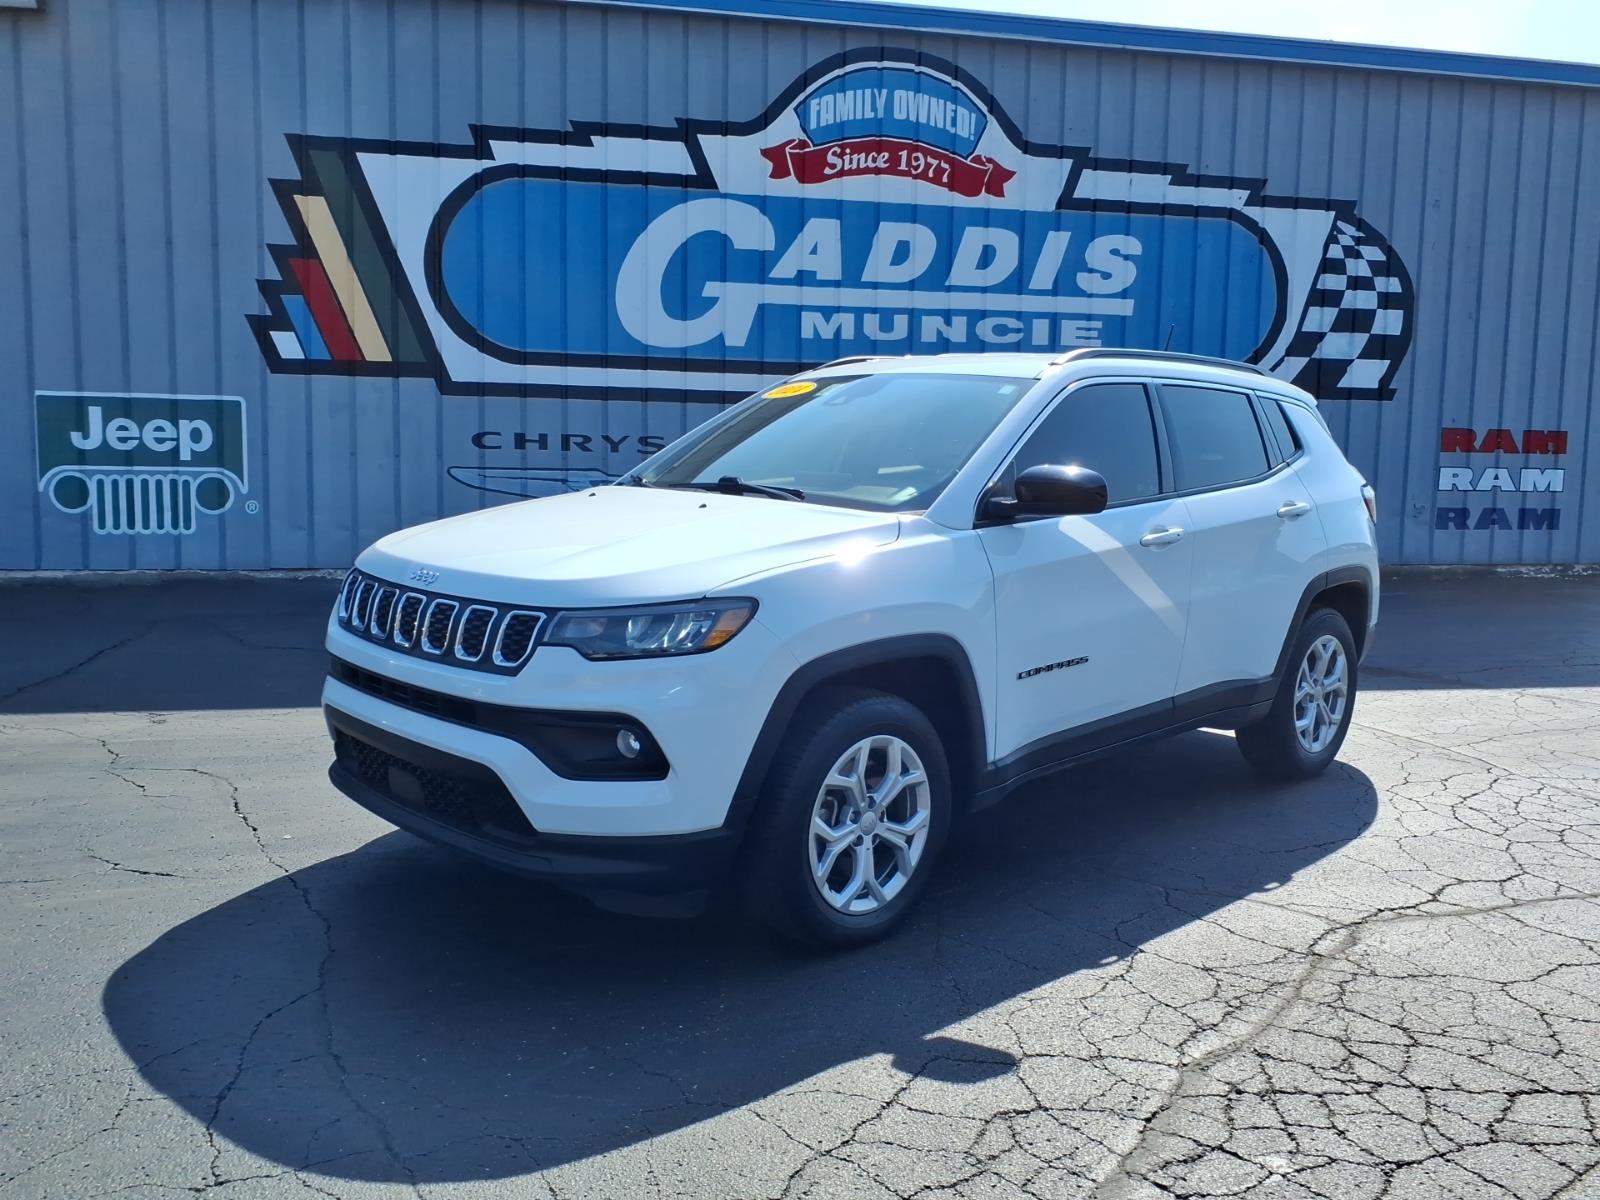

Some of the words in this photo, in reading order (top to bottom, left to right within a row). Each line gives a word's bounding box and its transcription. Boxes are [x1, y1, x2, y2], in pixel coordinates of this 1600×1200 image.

[810, 88, 887, 130] FAMILY
[893, 89, 976, 140] OWNED!
[823, 147, 889, 175] Since
[897, 150, 952, 183] 1977
[615, 197, 1143, 348] GADDIS
[800, 311, 1103, 347] MUNCIE
[70, 405, 213, 461] Jeep
[471, 431, 668, 455] CHRYS
[1440, 427, 1568, 454] RAM
[1437, 466, 1566, 492] RAM
[1434, 507, 1561, 530] RAM
[409, 567, 440, 586] Jeep
[1016, 655, 1089, 681] COMPASS
